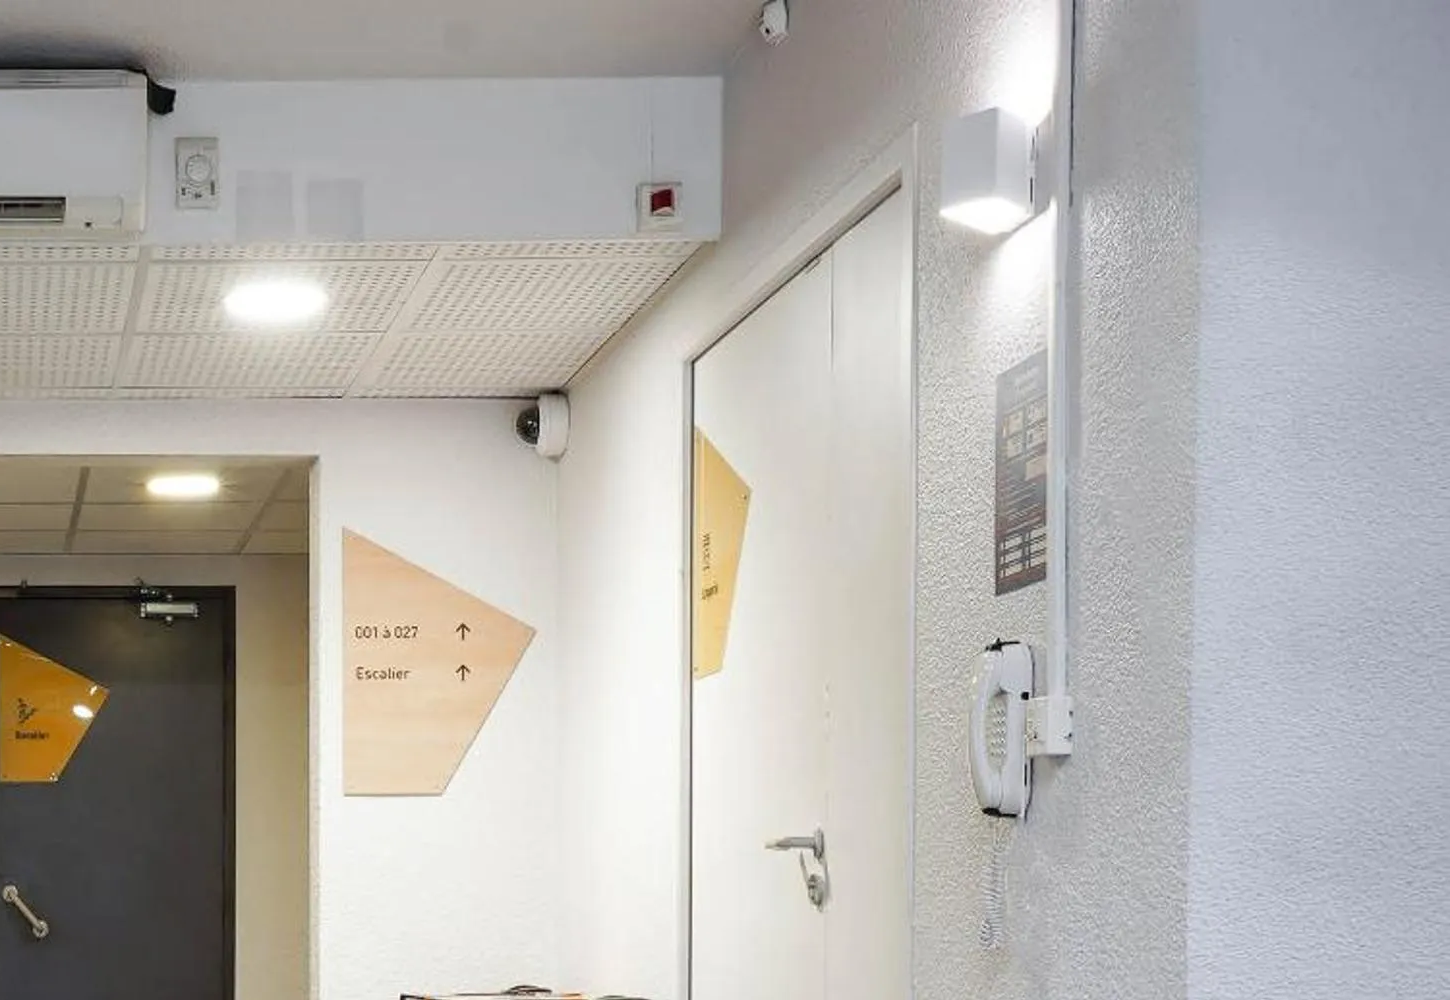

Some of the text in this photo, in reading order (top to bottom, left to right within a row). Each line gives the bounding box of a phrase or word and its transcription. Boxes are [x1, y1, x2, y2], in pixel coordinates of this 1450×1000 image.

[354, 624, 419, 640] 001 à 027
[355, 666, 411, 681] Escalier
